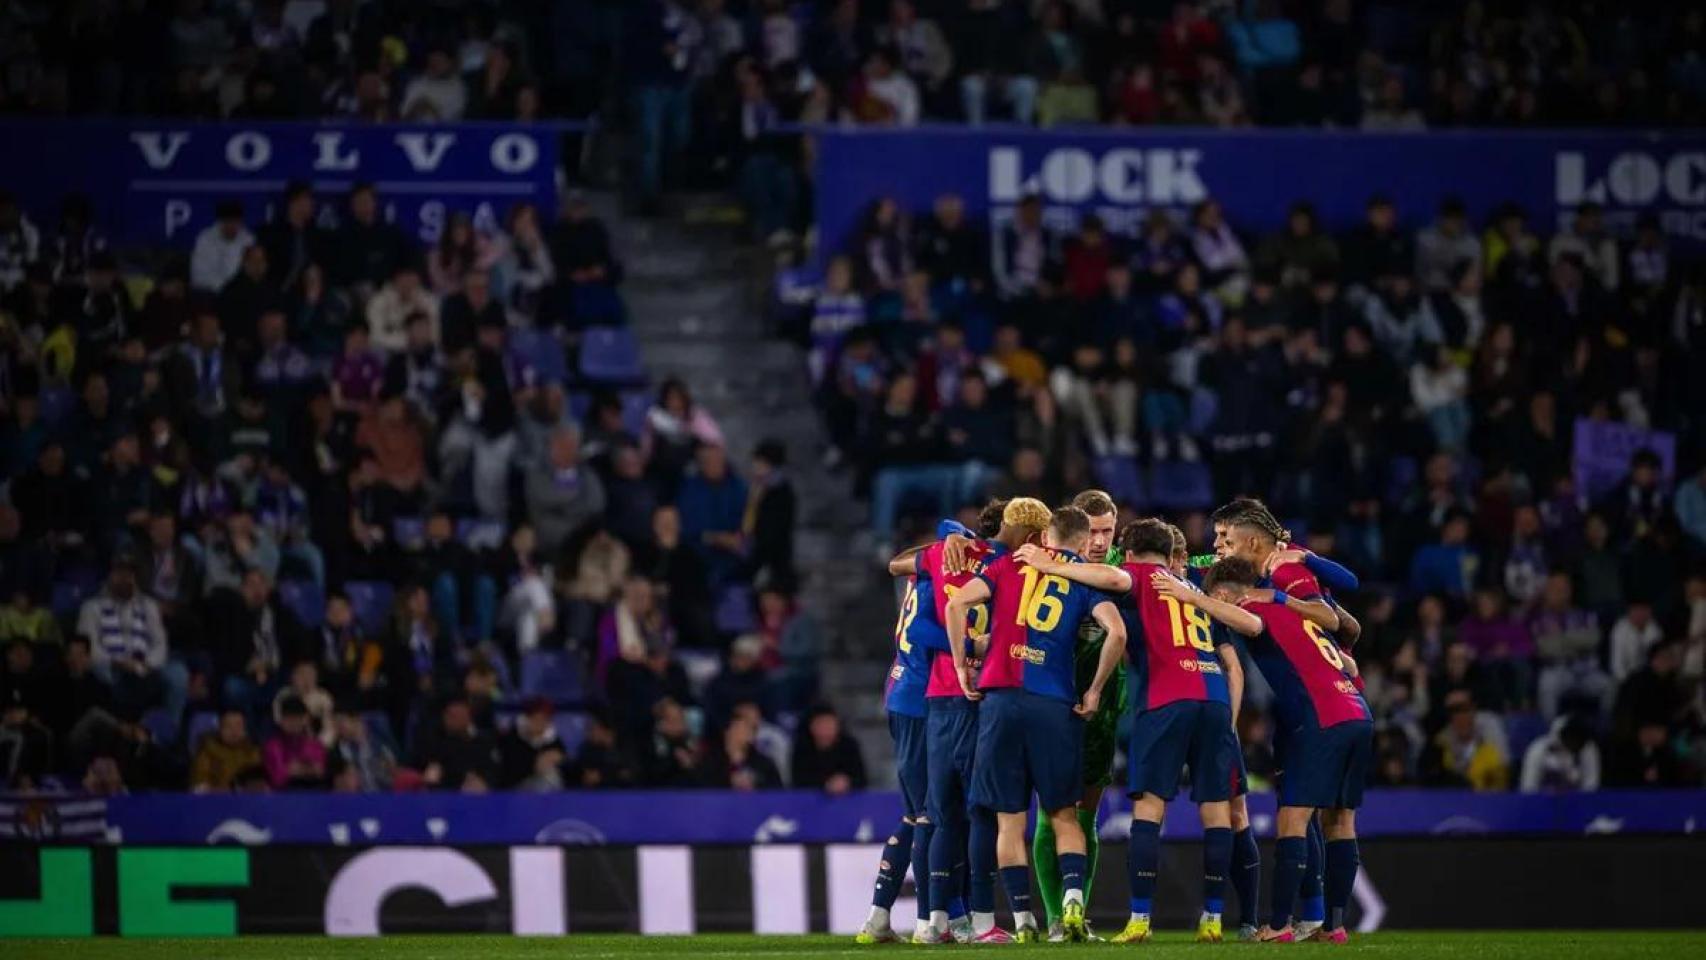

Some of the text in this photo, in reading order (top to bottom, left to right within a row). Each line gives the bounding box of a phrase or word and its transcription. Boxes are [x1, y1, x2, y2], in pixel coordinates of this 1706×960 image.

[130, 131, 542, 174] VOLVO
[988, 147, 1208, 204] LOCK
[896, 581, 918, 654] 12
[1016, 565, 1070, 633] 16
[1159, 594, 1215, 653] 18
[1303, 618, 1344, 671] 6
